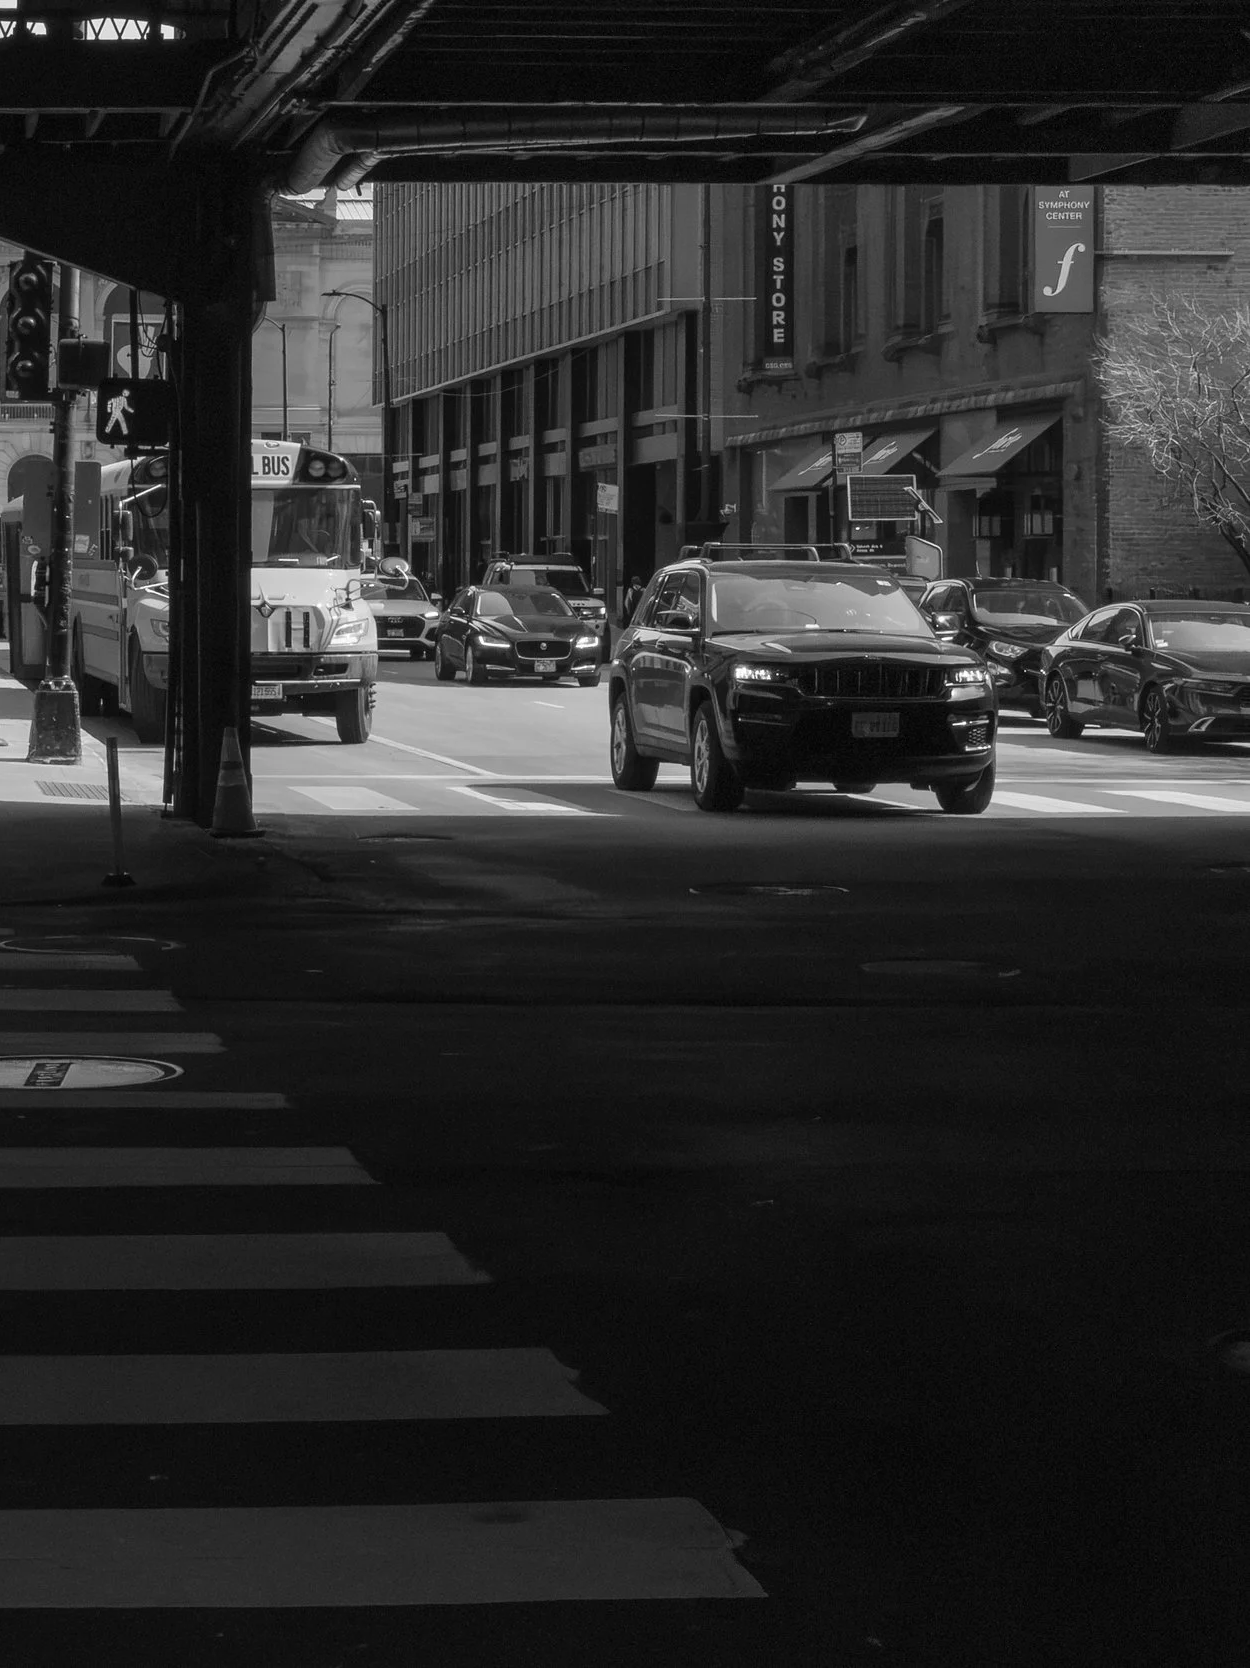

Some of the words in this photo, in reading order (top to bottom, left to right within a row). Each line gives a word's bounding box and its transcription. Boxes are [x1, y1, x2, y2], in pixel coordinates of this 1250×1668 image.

[1058, 190, 1070, 198] AT
[1038, 201, 1090, 209] SYMPHONY
[1045, 212, 1083, 220] CENTER
[771, 256, 786, 343] STORE
[262, 455, 290, 475] BUS
